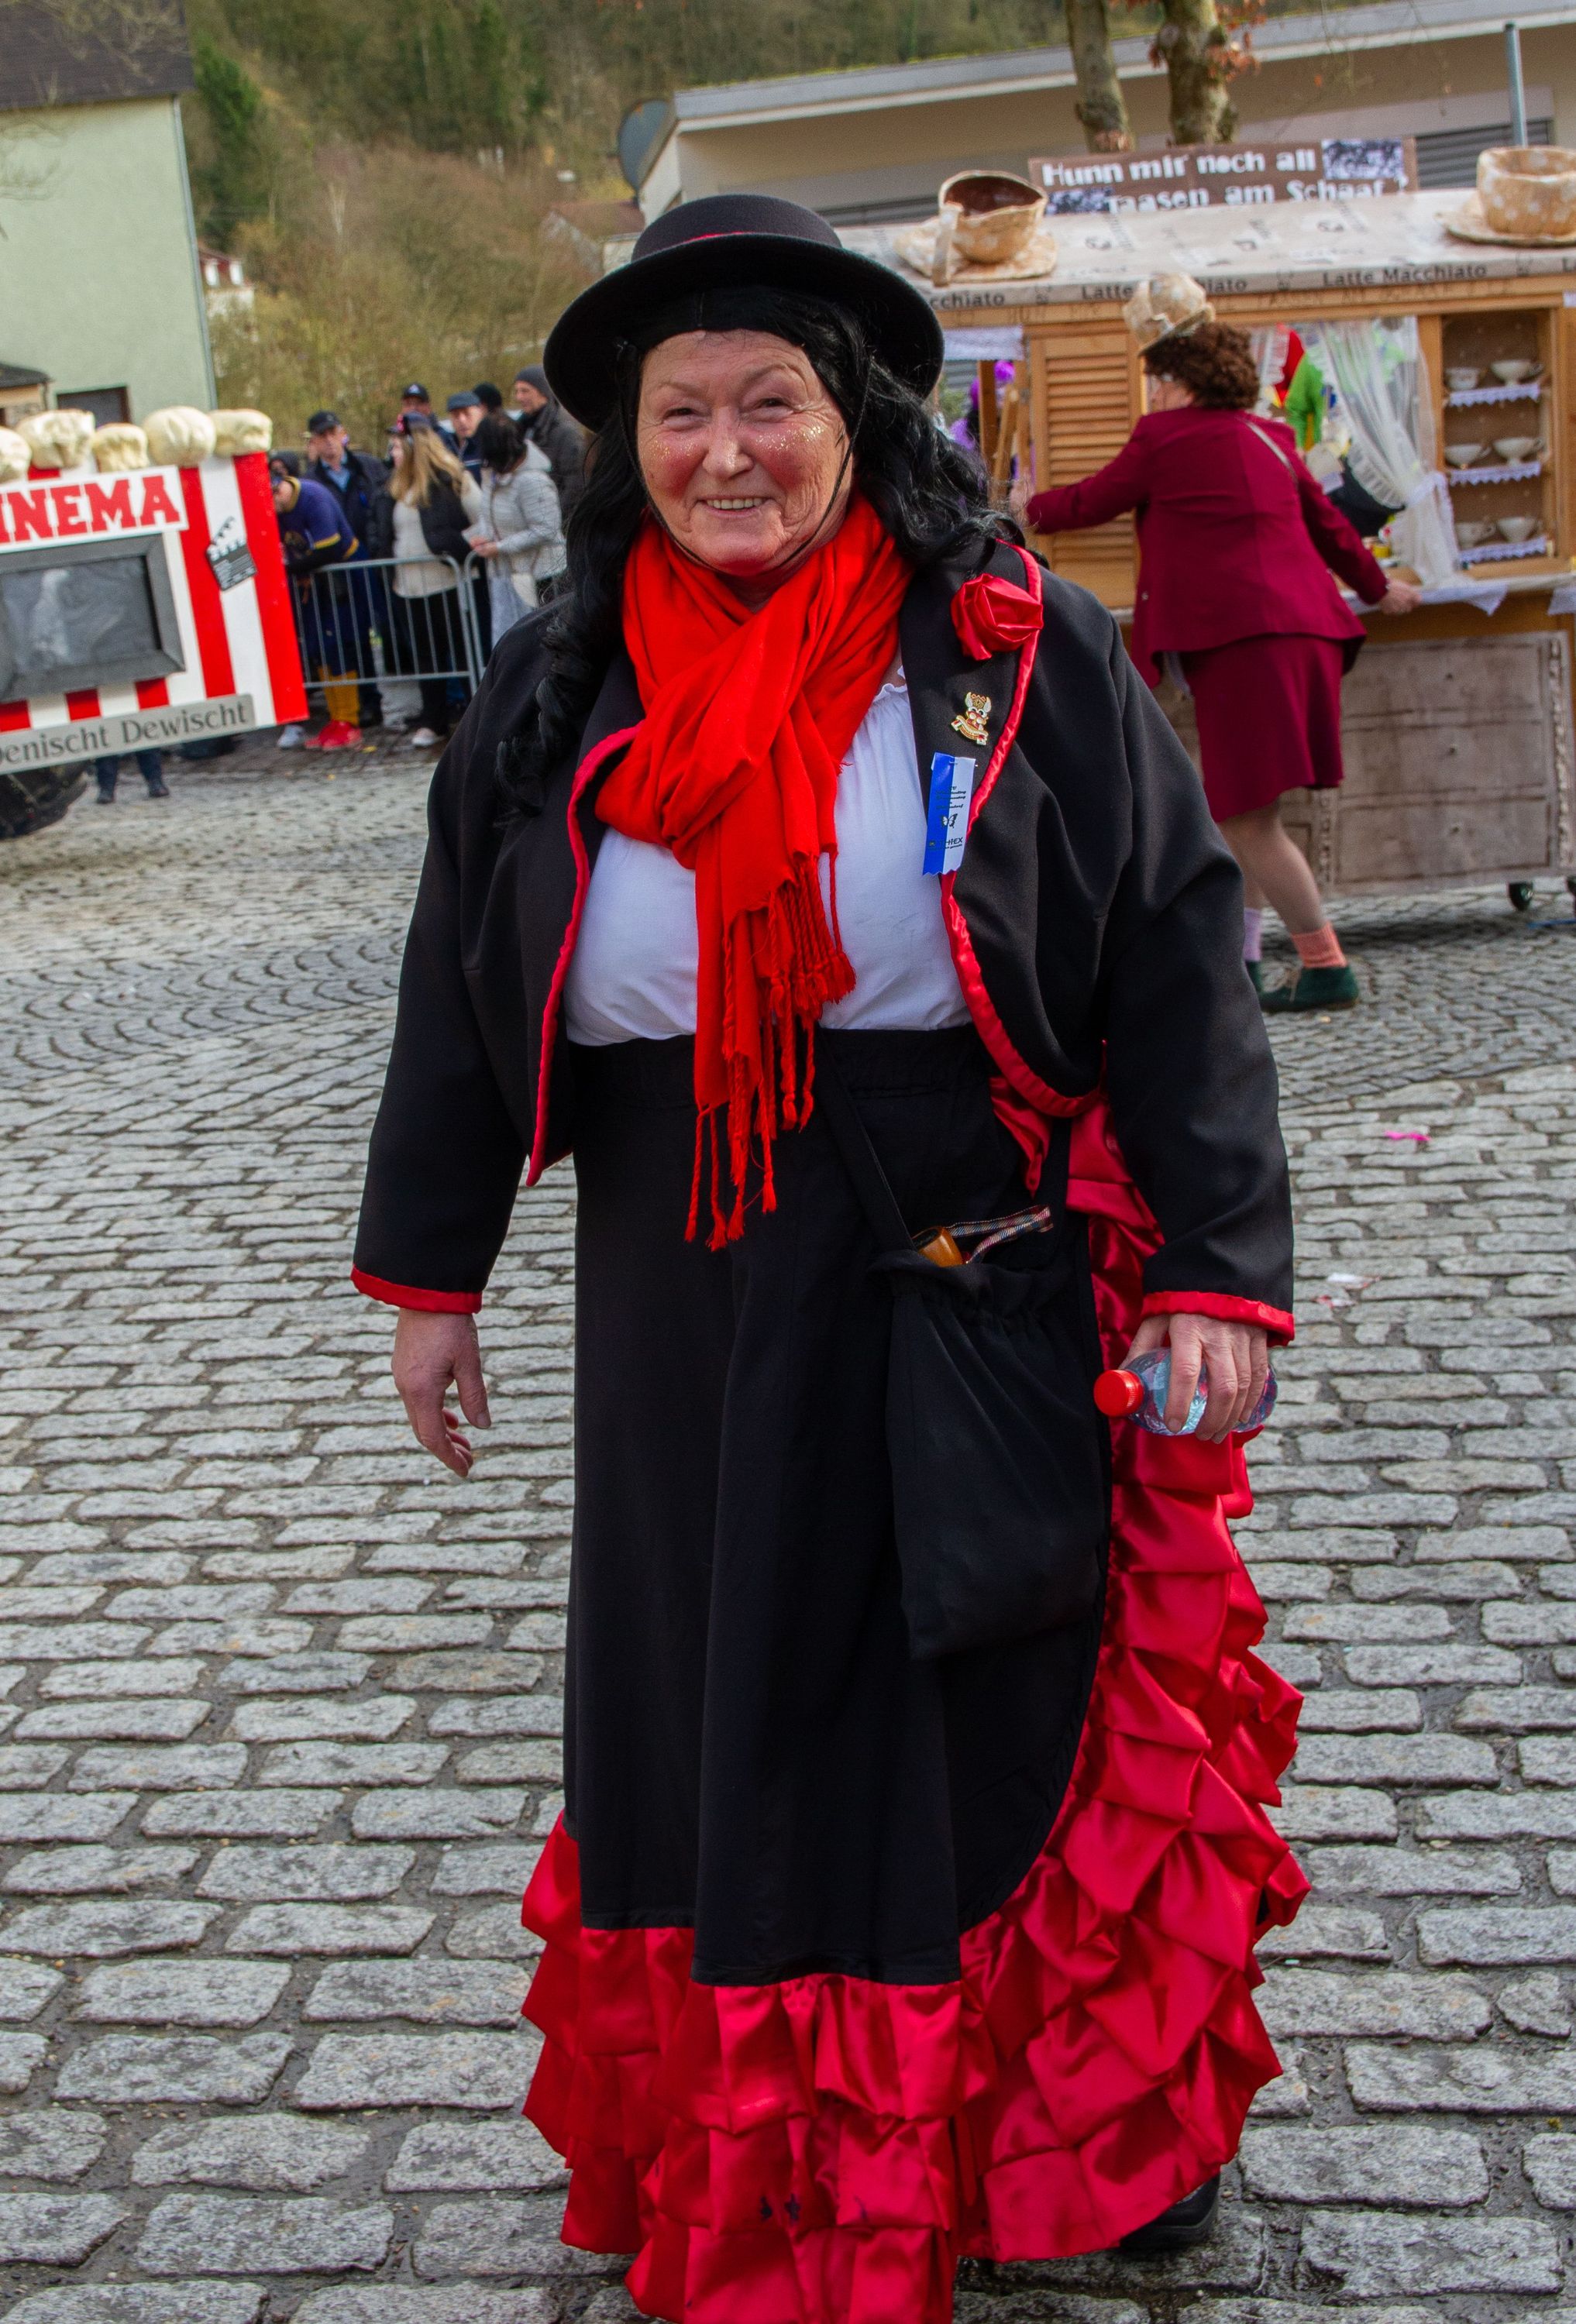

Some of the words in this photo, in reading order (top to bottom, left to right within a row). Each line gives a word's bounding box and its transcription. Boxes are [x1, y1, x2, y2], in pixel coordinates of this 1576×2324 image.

[1042, 162, 1124, 187] Hunn
[1276, 149, 1316, 171] all
[1224, 183, 1275, 205] am
[1323, 269, 1373, 287] Latte
[1382, 261, 1488, 284] Macchiato
[0, 725, 108, 764] enischt
[122, 703, 246, 743] Dewischt
